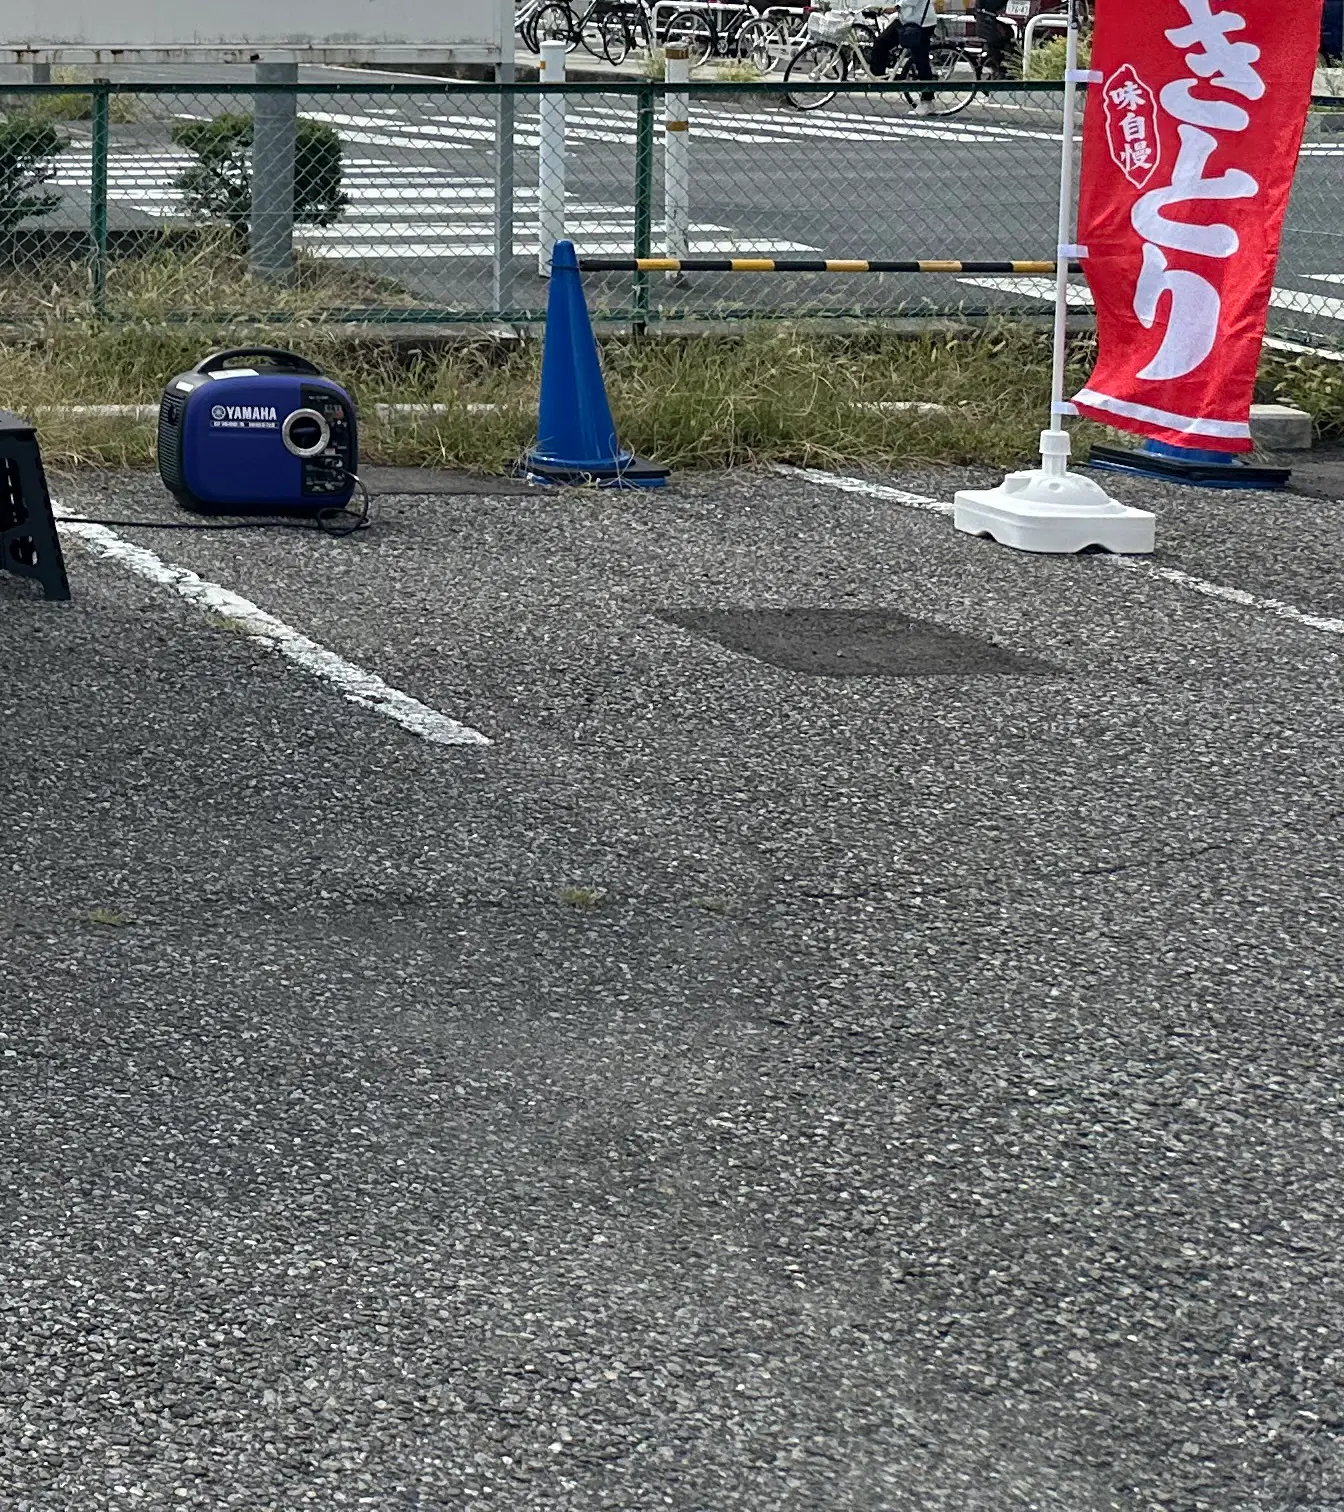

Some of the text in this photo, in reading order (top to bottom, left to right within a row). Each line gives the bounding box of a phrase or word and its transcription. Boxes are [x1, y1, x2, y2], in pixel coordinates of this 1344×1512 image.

[1108, 80, 1154, 173] 味自慢
[226, 406, 277, 421] YAMAHA
